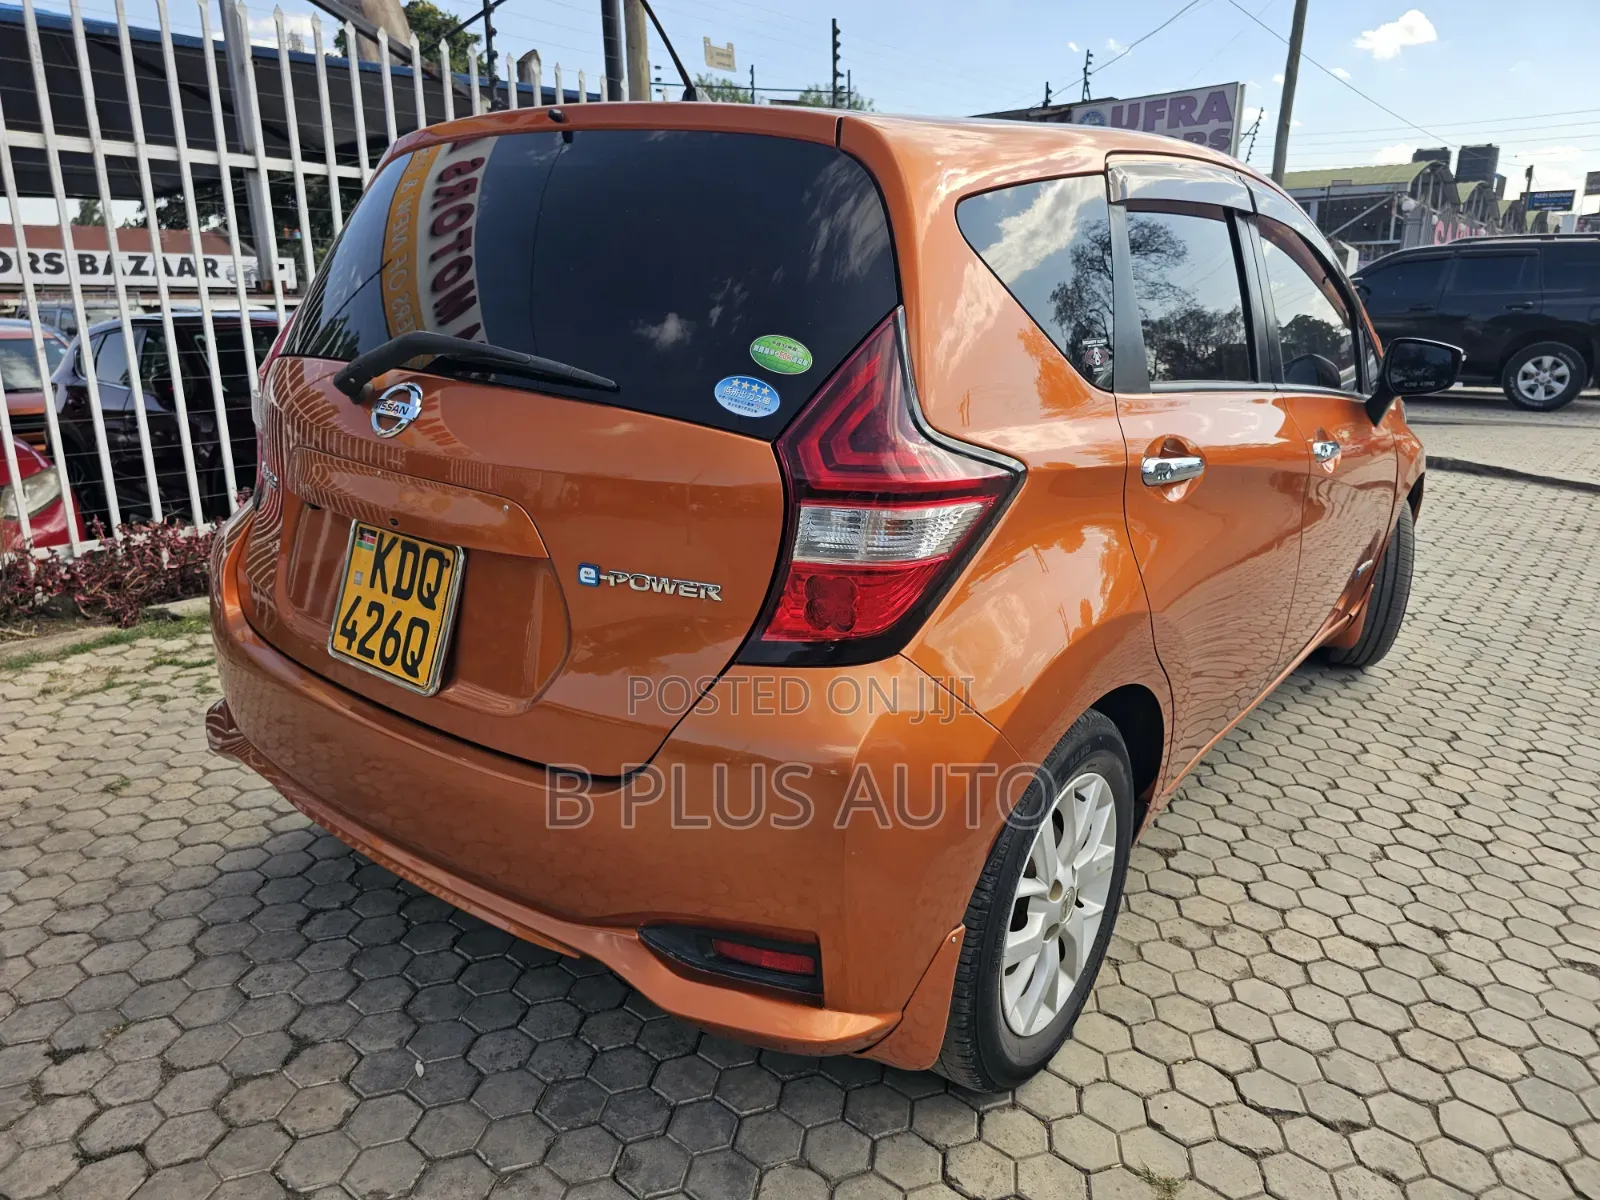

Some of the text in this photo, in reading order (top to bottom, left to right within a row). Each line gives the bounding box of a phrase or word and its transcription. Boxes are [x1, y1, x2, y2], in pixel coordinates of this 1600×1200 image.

[1111, 90, 1233, 132] UFRA
[77, 253, 220, 278] BAZAAR
[376, 399, 410, 415] NISSAN
[370, 530, 446, 610] KDQ
[339, 595, 430, 679] 426Q
